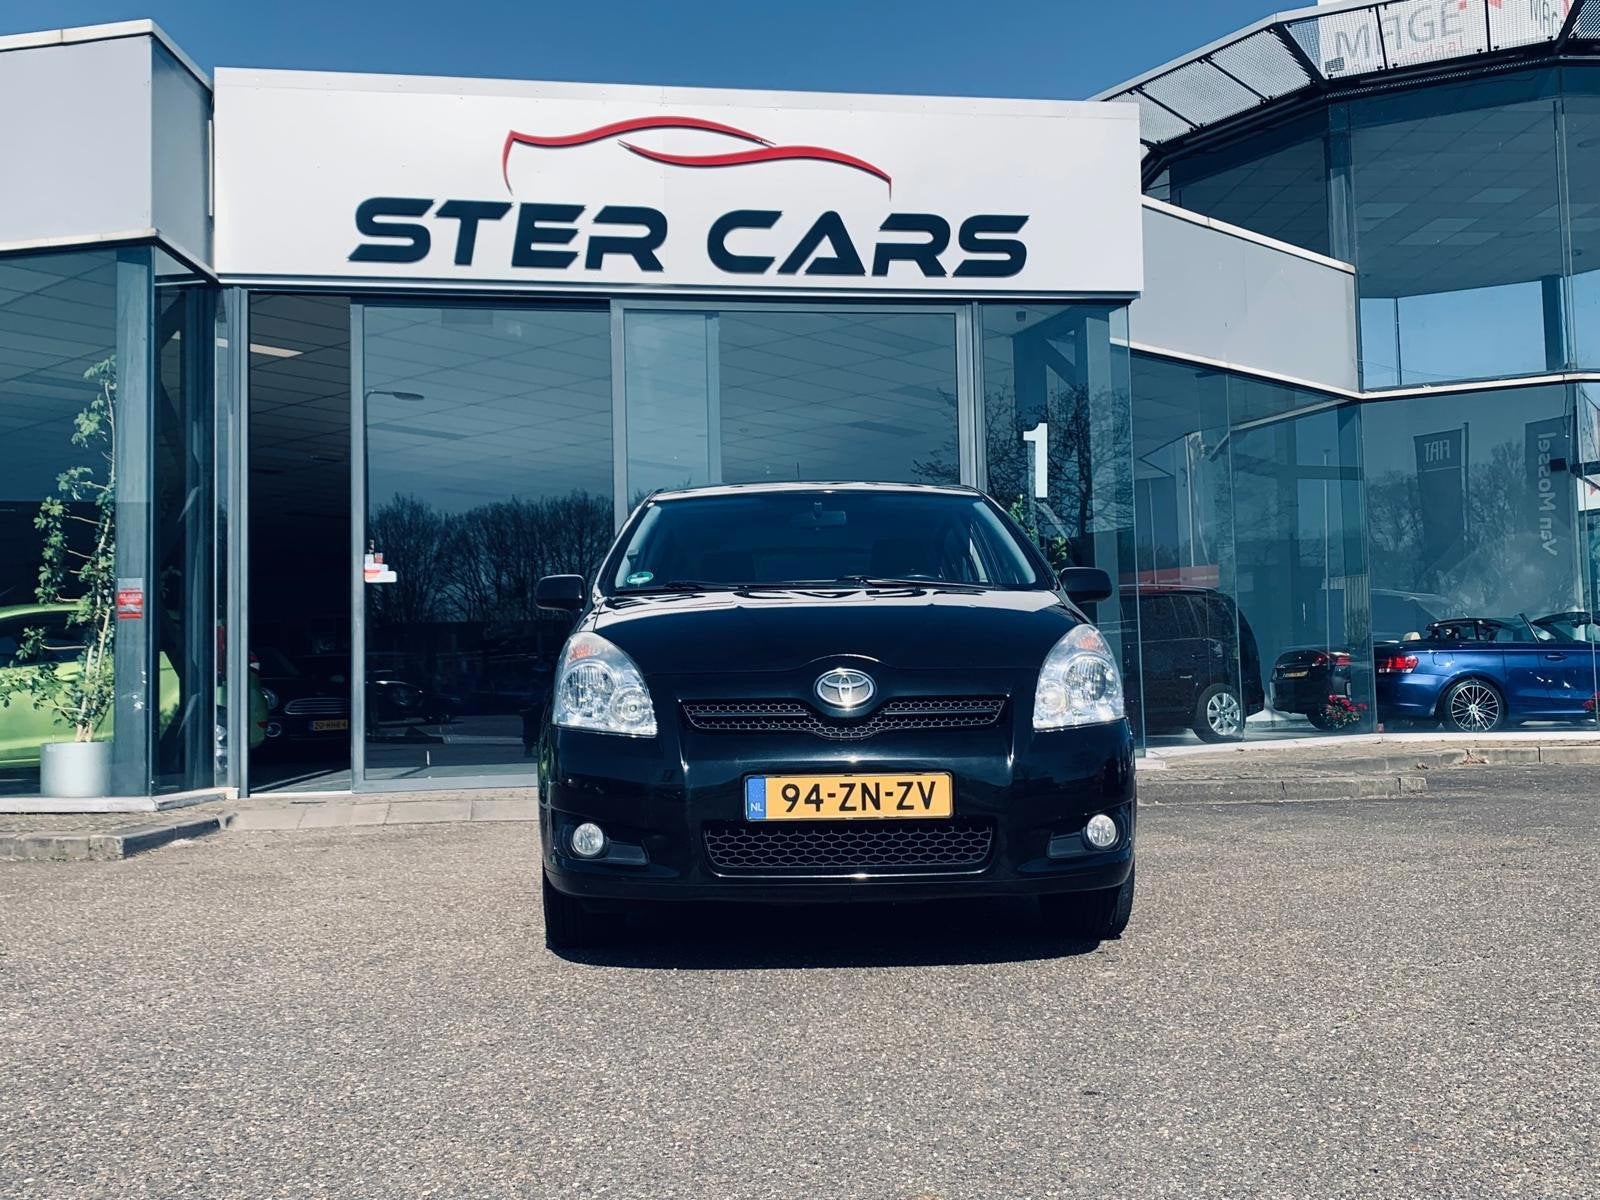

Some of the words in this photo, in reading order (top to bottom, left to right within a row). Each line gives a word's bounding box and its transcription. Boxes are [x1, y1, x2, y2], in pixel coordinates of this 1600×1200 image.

[347, 197, 668, 273] STER
[707, 210, 1030, 278] CARS
[1023, 423, 1048, 498] 1
[750, 803, 764, 813] NL
[781, 781, 936, 813] 94-ZN-ZV
